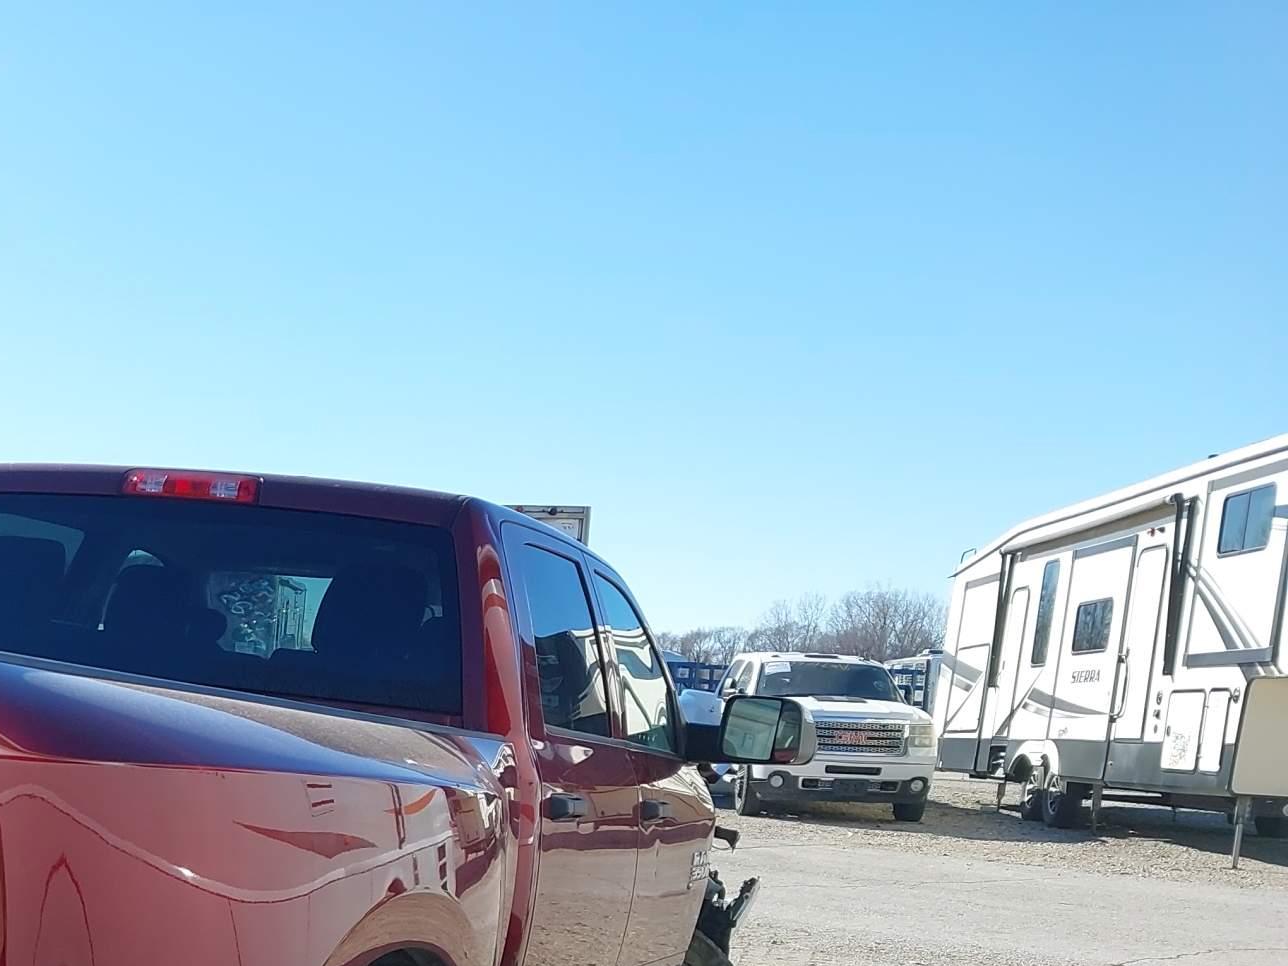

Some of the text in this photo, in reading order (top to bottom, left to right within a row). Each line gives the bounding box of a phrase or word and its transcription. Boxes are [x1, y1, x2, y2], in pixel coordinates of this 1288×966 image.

[1071, 670, 1100, 683] SIERRA
[835, 731, 868, 744] GMC
[691, 851, 708, 865] RA
